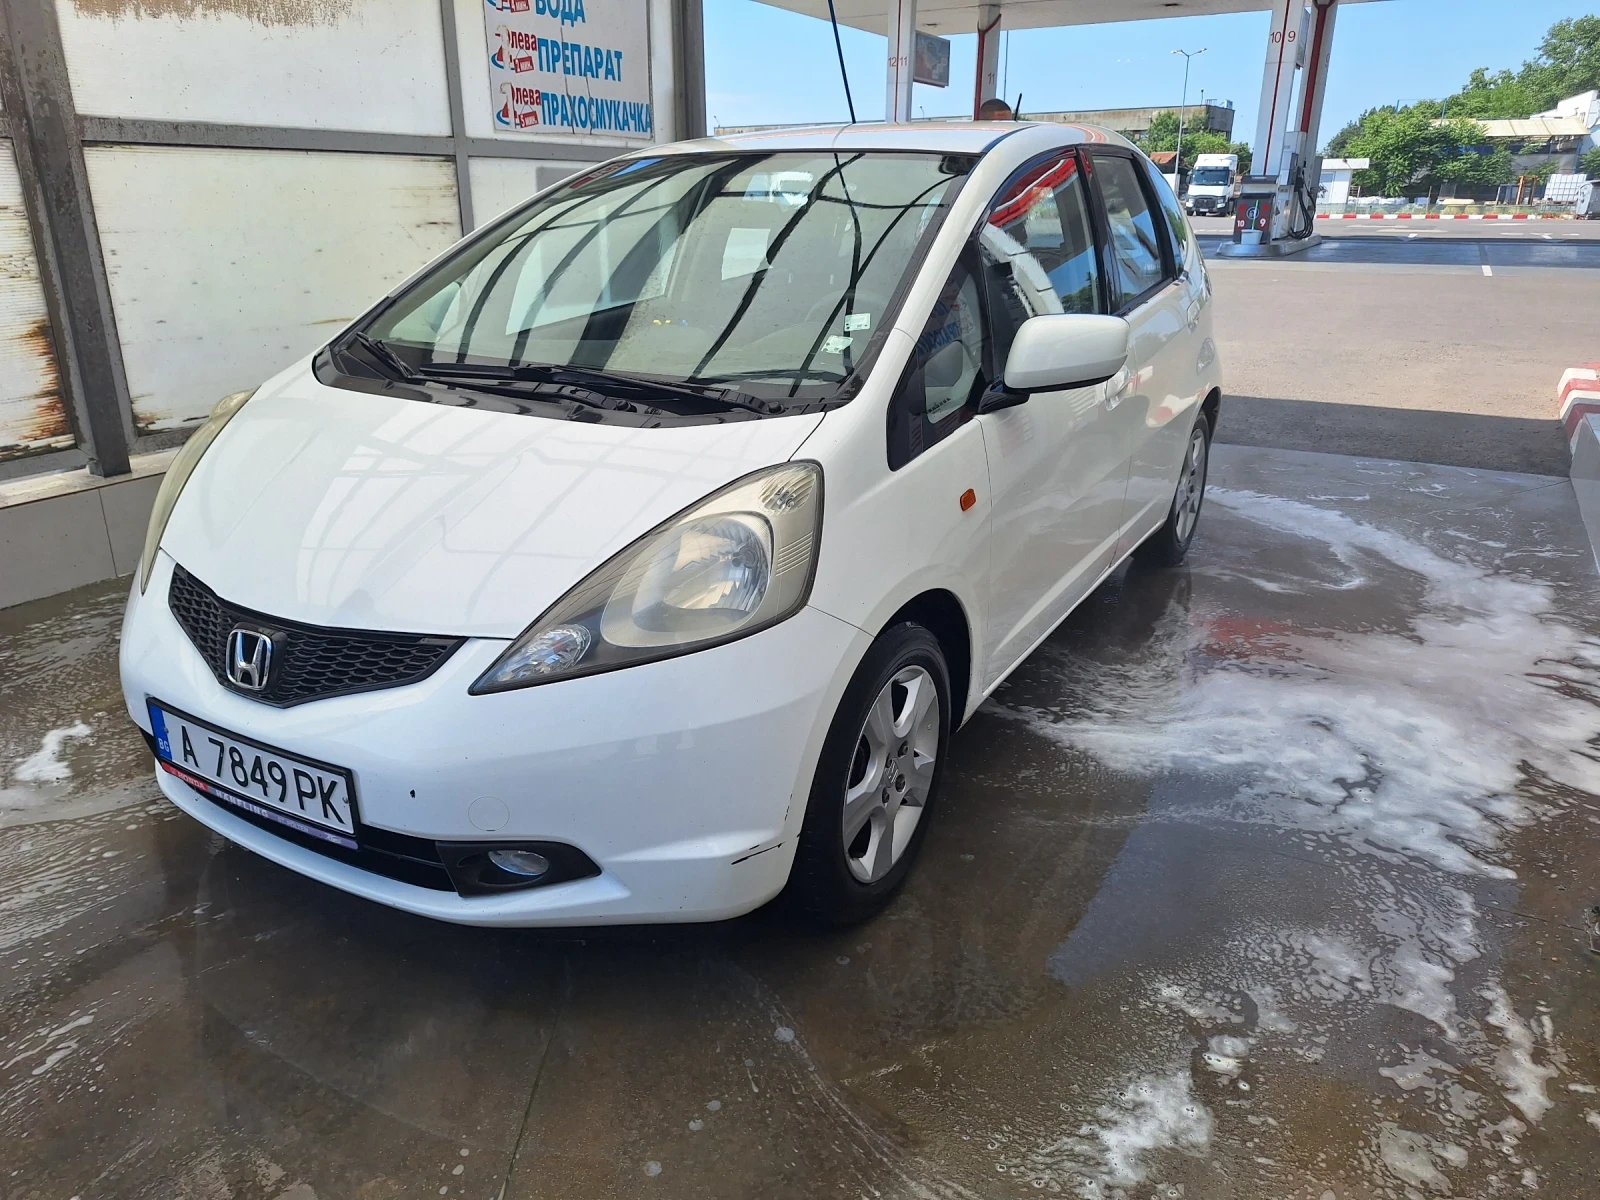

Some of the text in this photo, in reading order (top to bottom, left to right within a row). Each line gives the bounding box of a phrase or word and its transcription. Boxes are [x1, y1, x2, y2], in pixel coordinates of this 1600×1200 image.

[511, 31, 537, 51] лева
[1270, 31, 1282, 43] 10
[1287, 30, 1296, 42] 9
[537, 38, 622, 82] ПРЕПАРАТ
[888, 57, 897, 67] 12
[899, 57, 908, 67] 11
[515, 87, 541, 106] лева
[541, 92, 652, 133] ПРАХОСМУКАЧКА
[1259, 218, 1266, 227] 9
[158, 736, 170, 753] BG
[177, 771, 206, 791] HONDA
[181, 725, 345, 825] A 7849 PK
